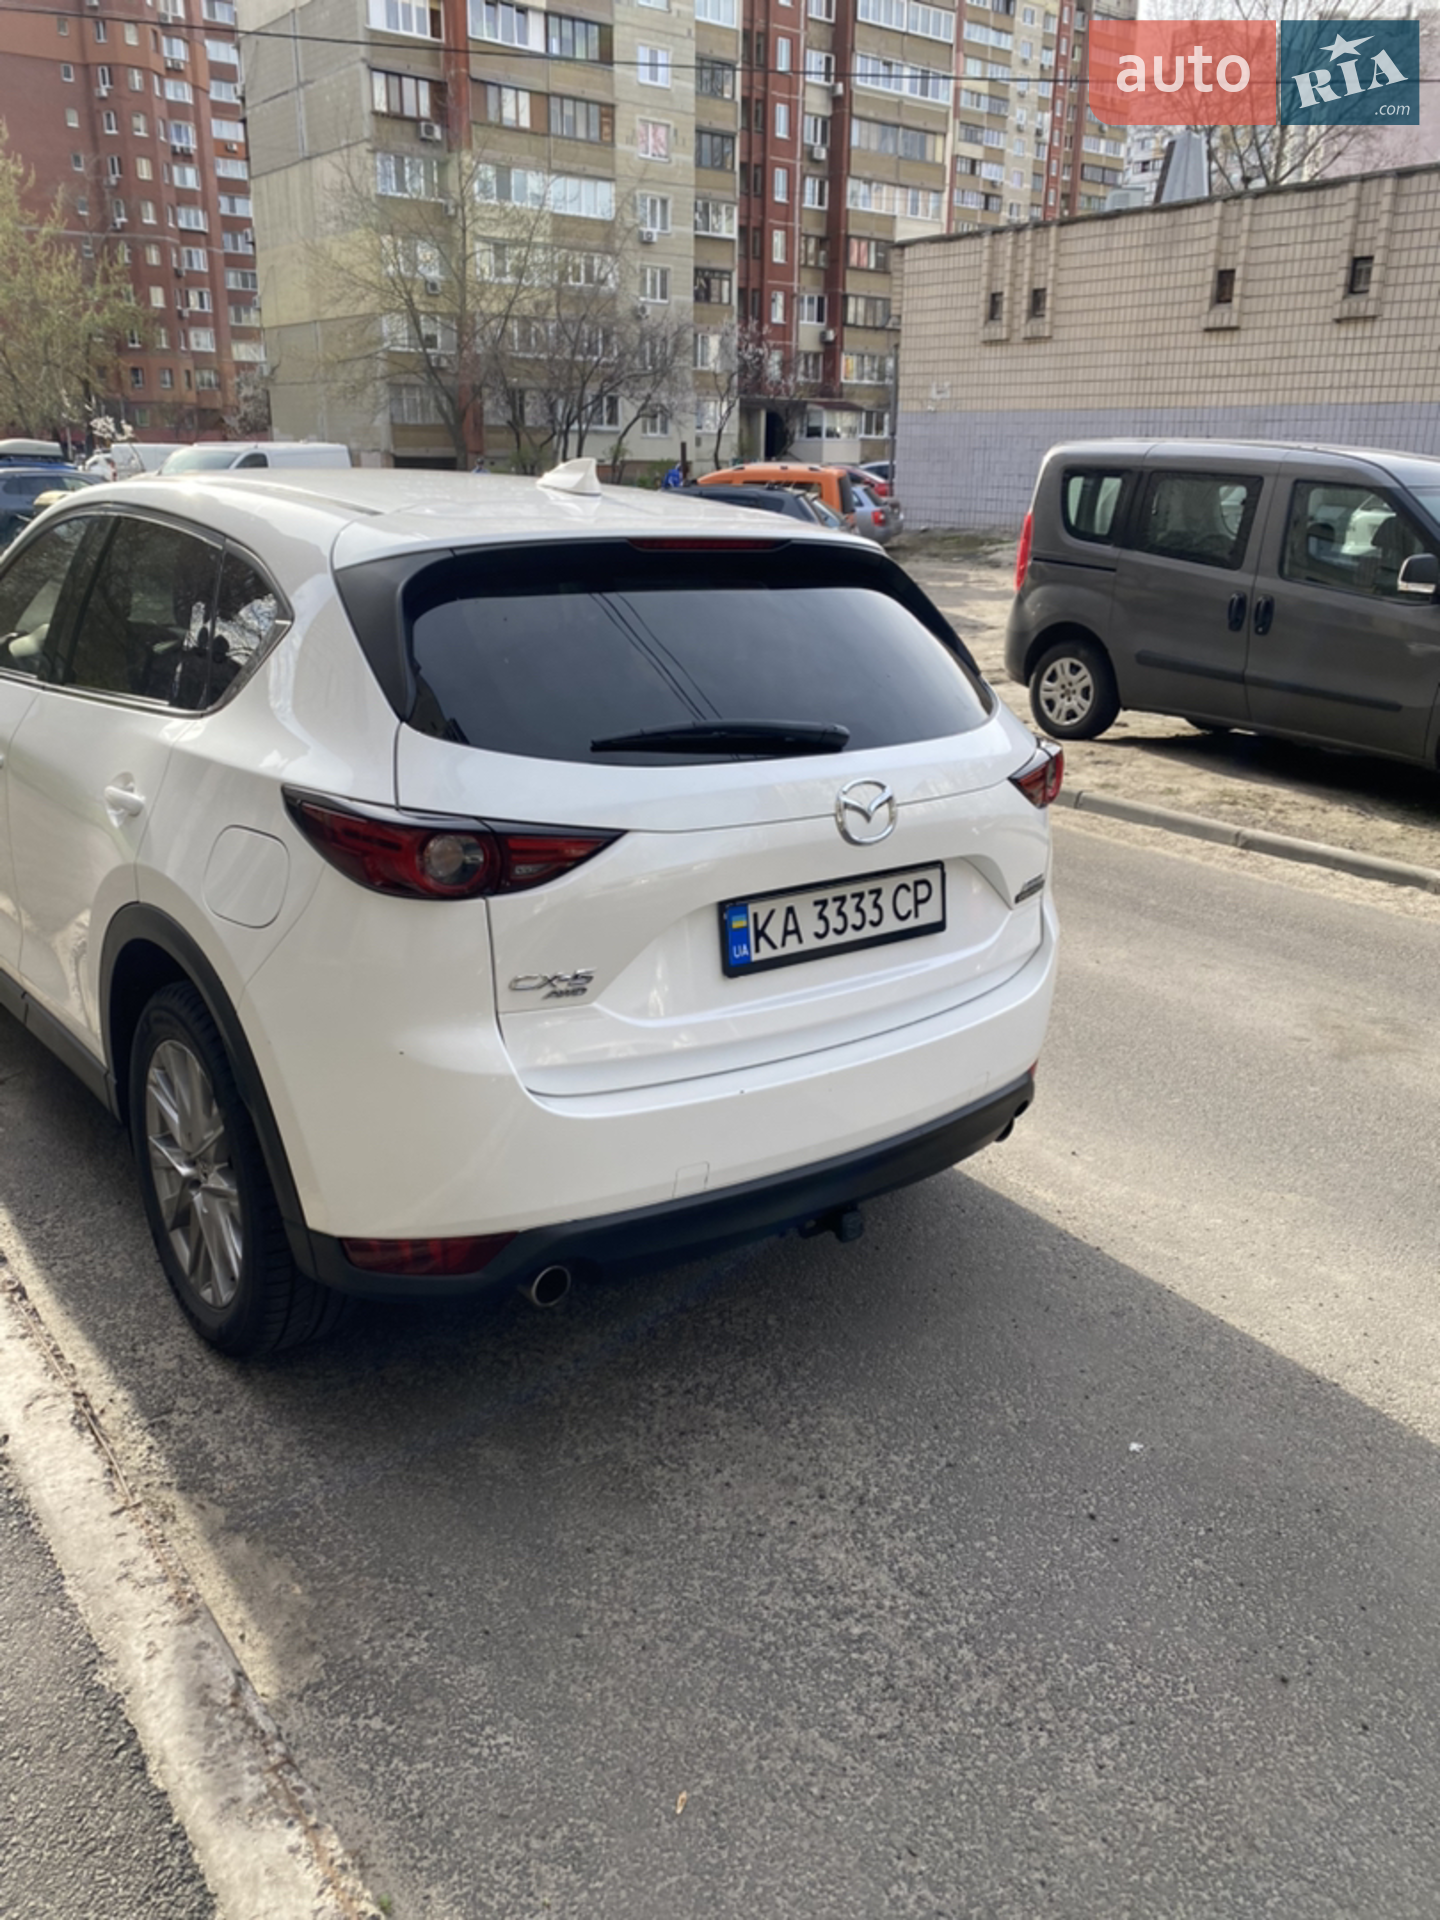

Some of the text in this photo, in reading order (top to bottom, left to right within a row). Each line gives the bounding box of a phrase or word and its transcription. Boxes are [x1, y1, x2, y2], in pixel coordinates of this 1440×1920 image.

[753, 878, 933, 953] KA 3333 CP
[732, 943, 749, 959] UA
